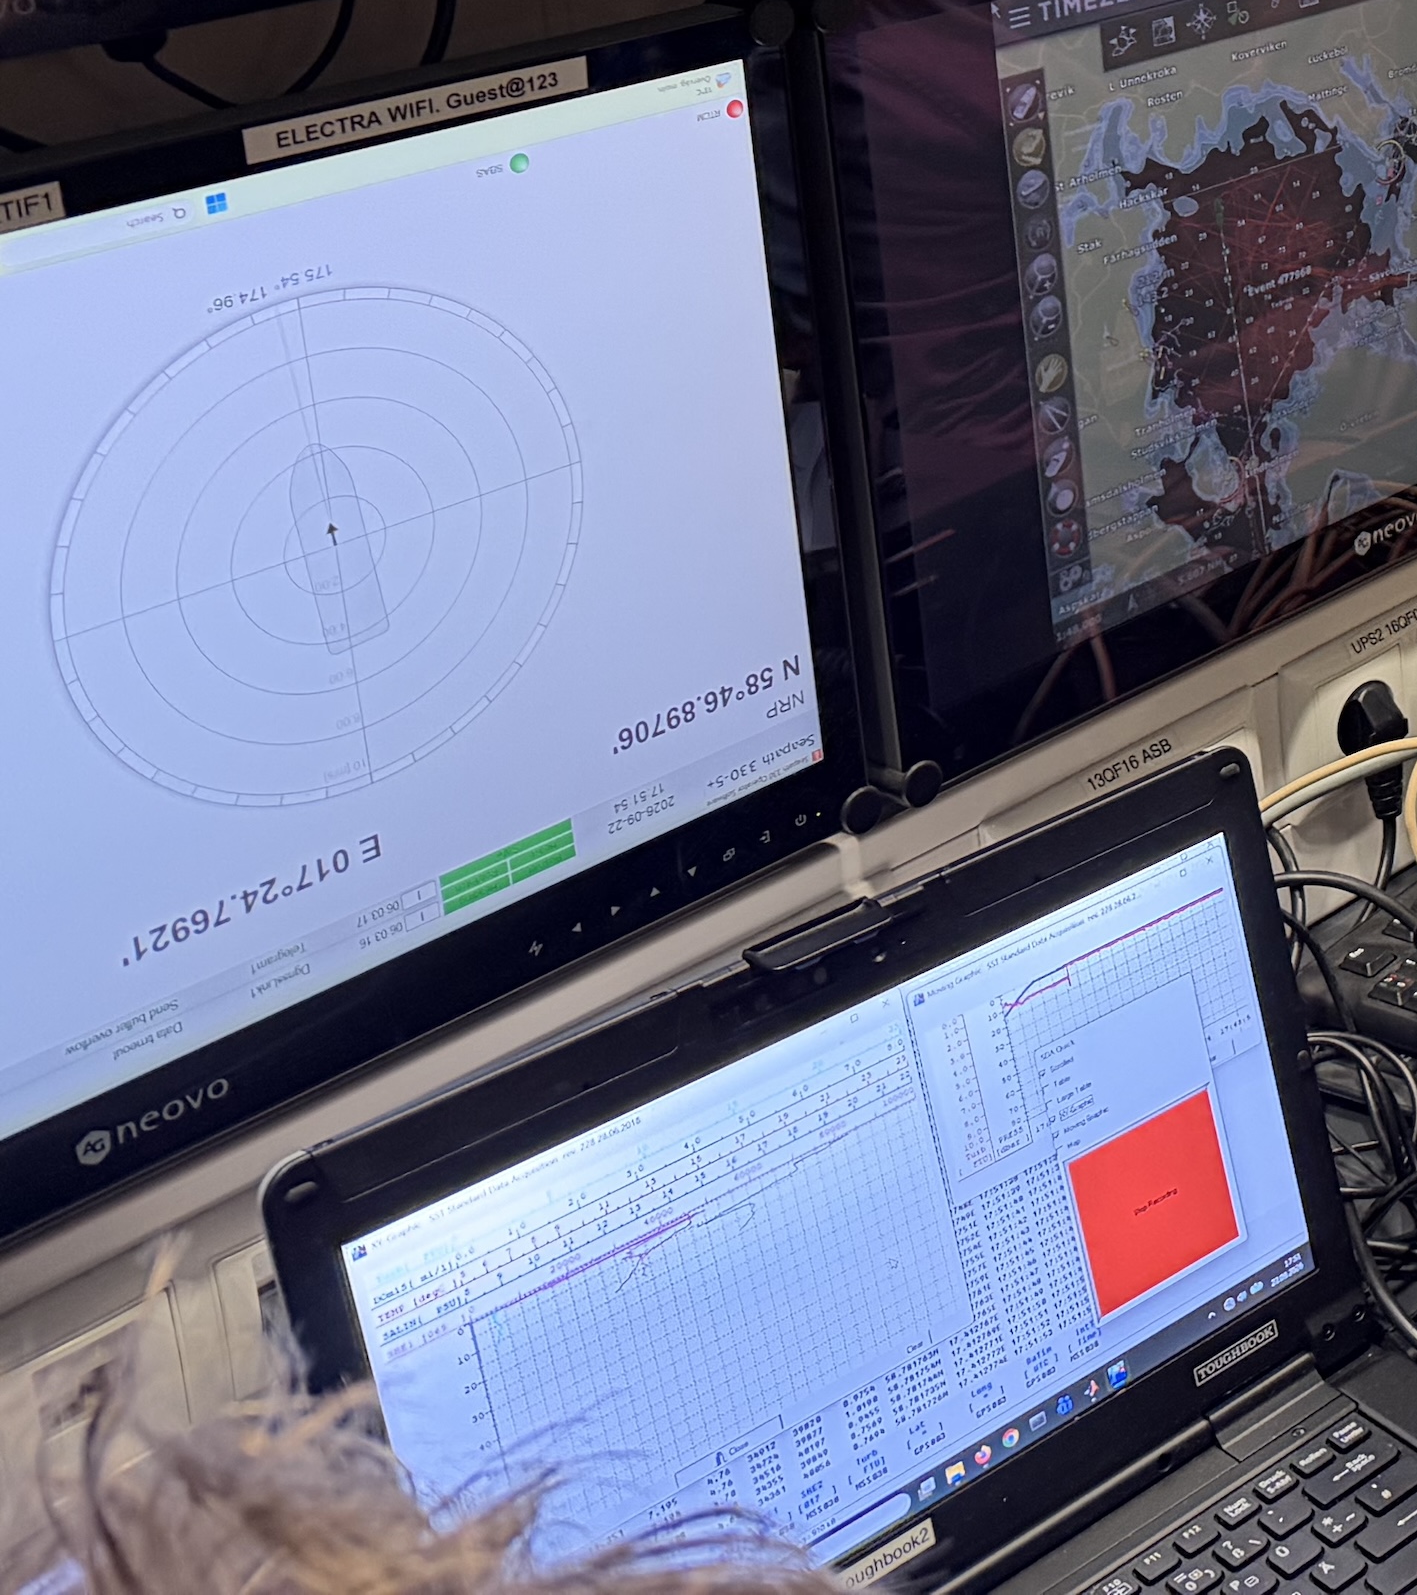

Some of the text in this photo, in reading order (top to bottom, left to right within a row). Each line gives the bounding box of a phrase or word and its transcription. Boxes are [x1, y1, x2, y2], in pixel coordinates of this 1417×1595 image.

[276, 70, 559, 149] ELECTRA WIFI. Guest@123
[1350, 629, 1385, 655] UPS2
[781, 653, 802, 682] N
[766, 689, 807, 722] NRP
[760, 732, 816, 769] Seapath
[1087, 738, 1173, 791] 13QF16 ASB
[359, 832, 382, 865] E
[115, 1077, 230, 1146] neovo
[1197, 1322, 1276, 1381] TOUGHBOOK
[1182, 1524, 1203, 1539] F12
[845, 1523, 932, 1587] oughbook2
